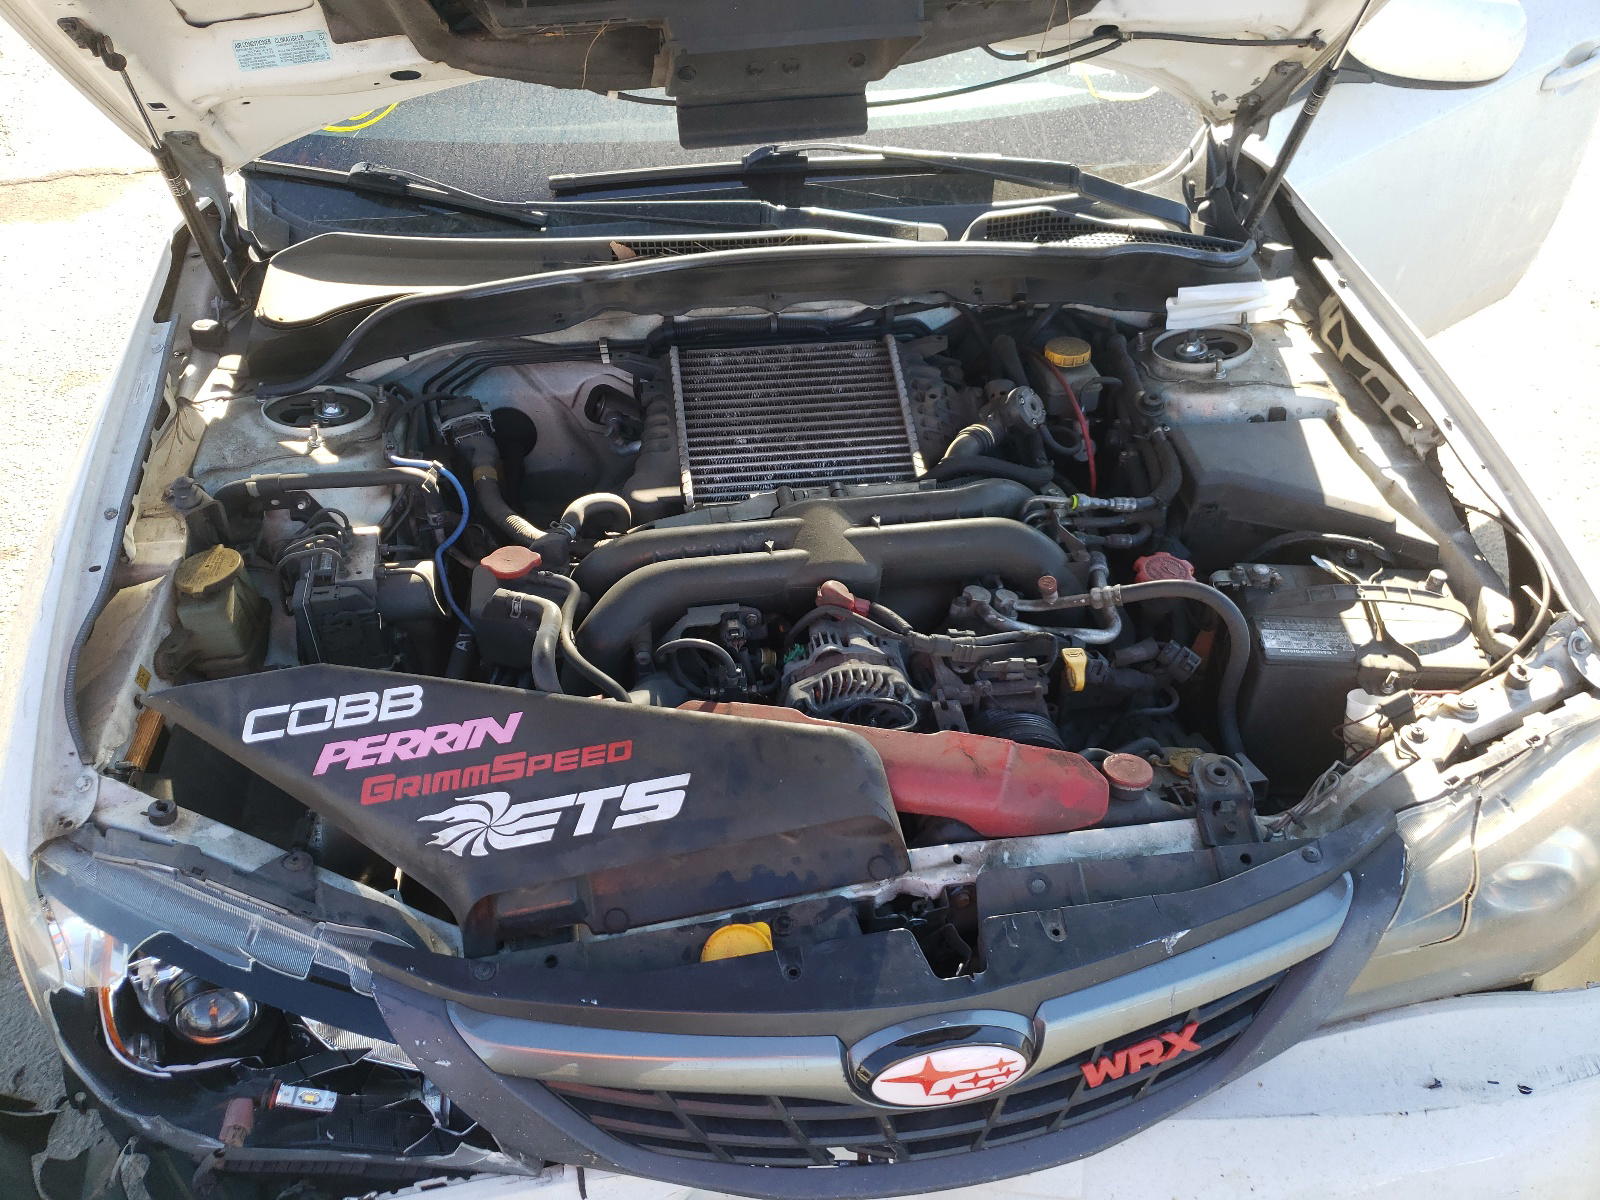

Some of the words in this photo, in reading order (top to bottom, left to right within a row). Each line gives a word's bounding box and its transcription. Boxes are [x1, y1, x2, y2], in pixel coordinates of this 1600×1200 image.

[242, 685, 424, 744] COBB
[312, 711, 524, 776] PERRIN
[488, 773, 691, 852] ETS
[1081, 1020, 1201, 1088] WRX
